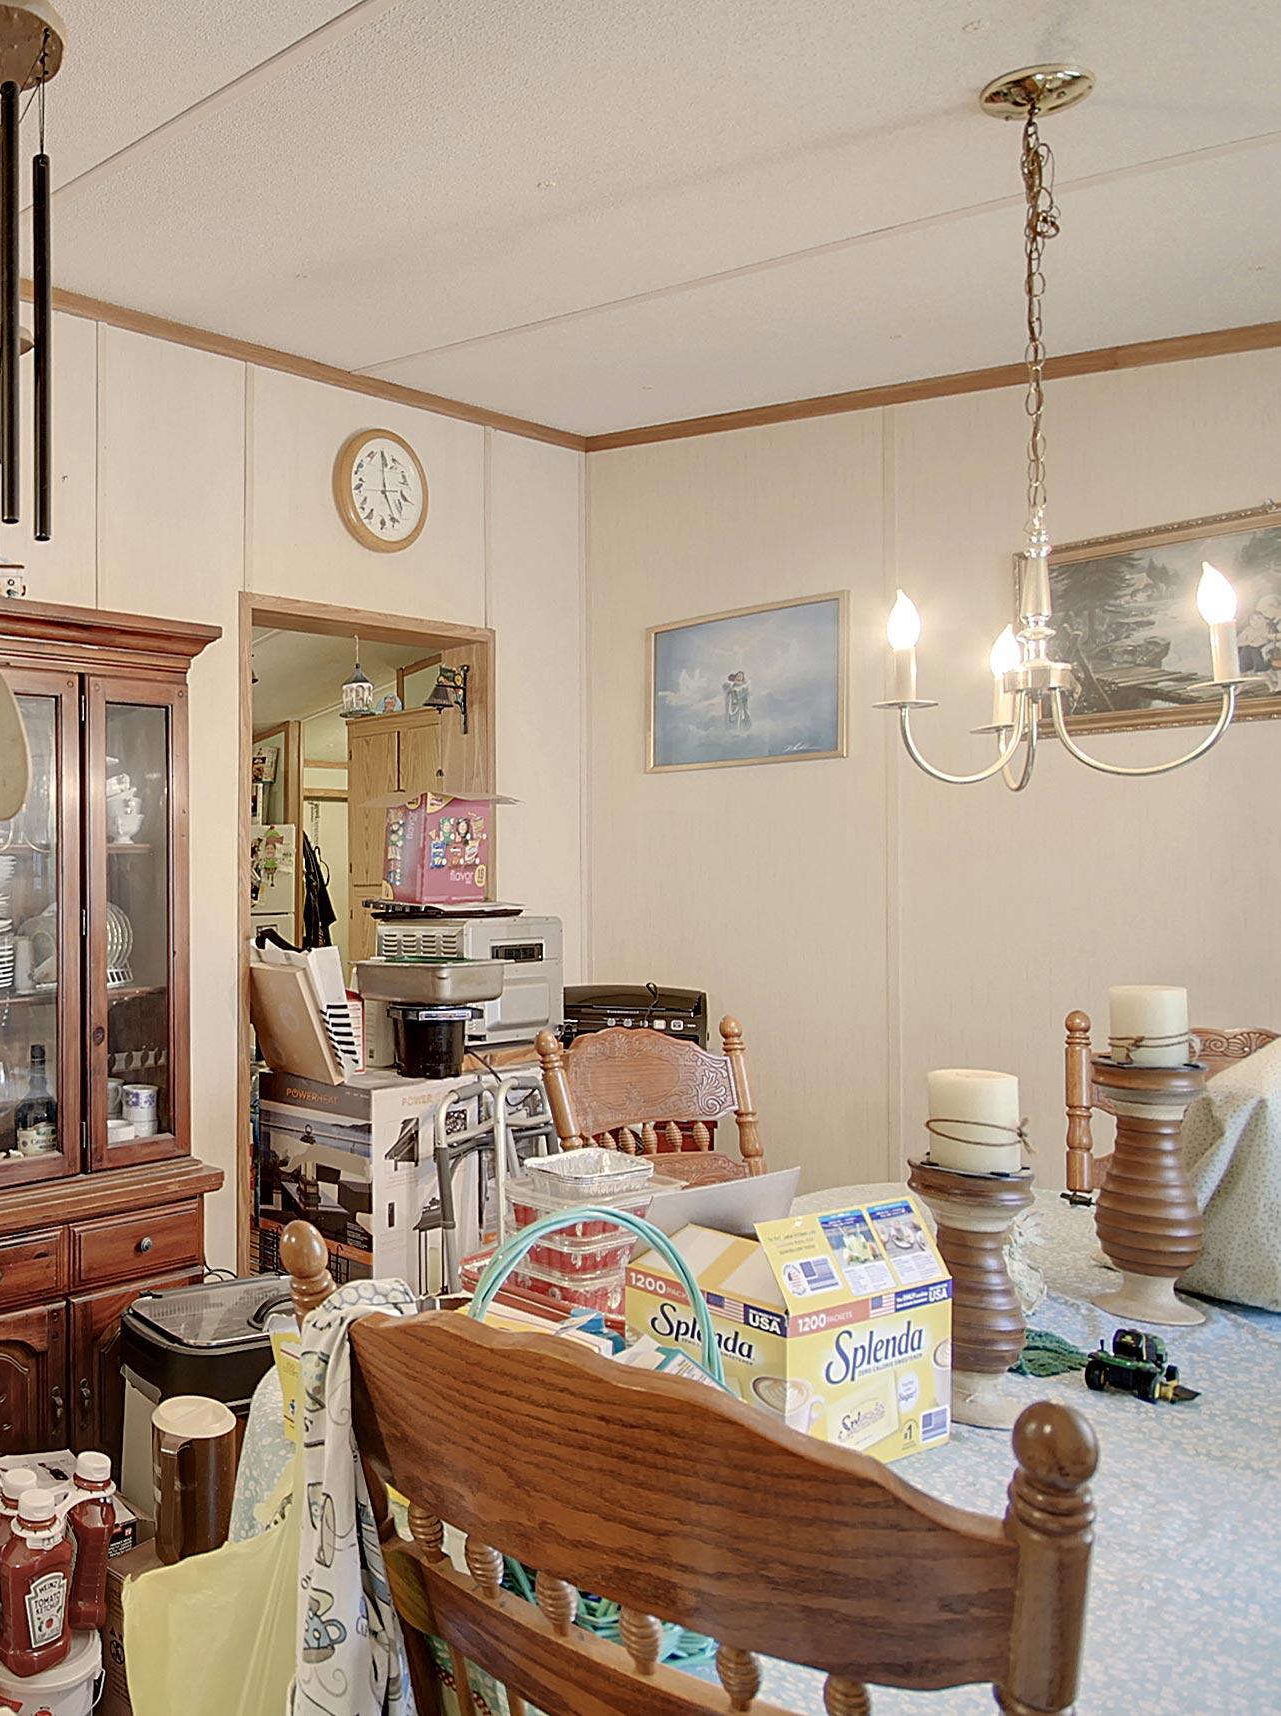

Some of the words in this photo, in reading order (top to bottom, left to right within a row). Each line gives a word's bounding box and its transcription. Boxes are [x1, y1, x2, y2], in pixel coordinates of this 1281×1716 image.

[630, 1272, 666, 1295] 1200
[928, 1287, 948, 1302] USA
[650, 1302, 754, 1360] Splnda
[748, 1314, 781, 1335] USA
[798, 1313, 827, 1333] 1200
[825, 1320, 923, 1385] Splenda
[39, 1580, 58, 1594] HEINZ
[34, 1590, 61, 1608] TOMATO
